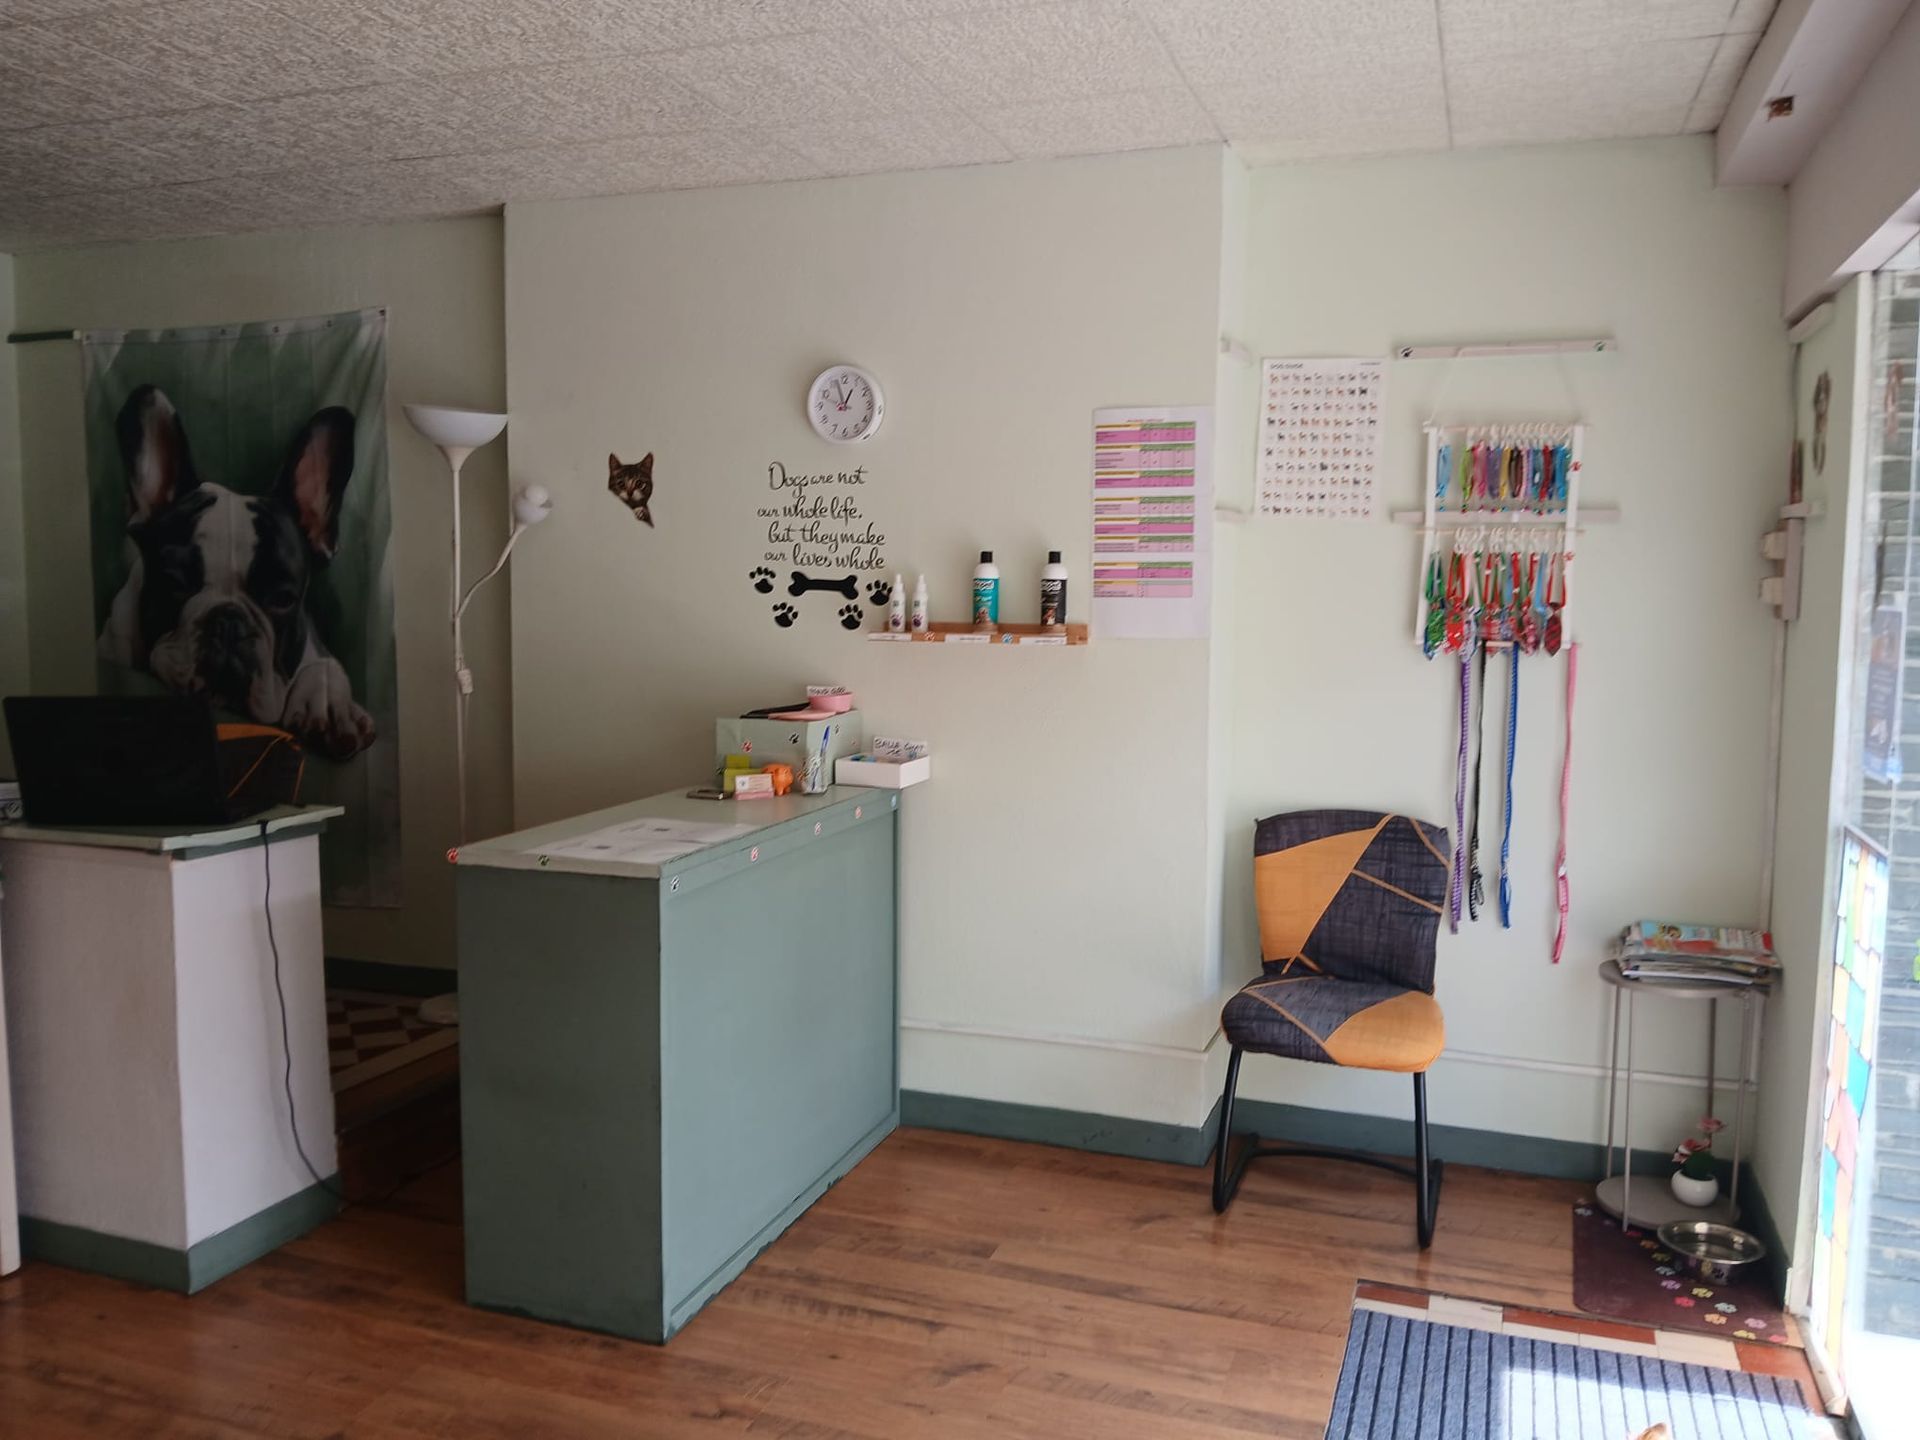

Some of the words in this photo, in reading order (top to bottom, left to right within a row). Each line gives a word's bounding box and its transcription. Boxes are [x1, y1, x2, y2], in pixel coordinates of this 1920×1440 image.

[768, 461, 808, 498] Dogs
[810, 473, 834, 485] are
[838, 465, 869, 485] not
[757, 507, 780, 518] our
[783, 495, 828, 519] whole
[768, 520, 796, 544] but
[801, 520, 839, 553] they
[840, 522, 886, 546] make
[764, 551, 787, 562] our
[792, 543, 832, 567] lives
[836, 546, 885, 570] whole
